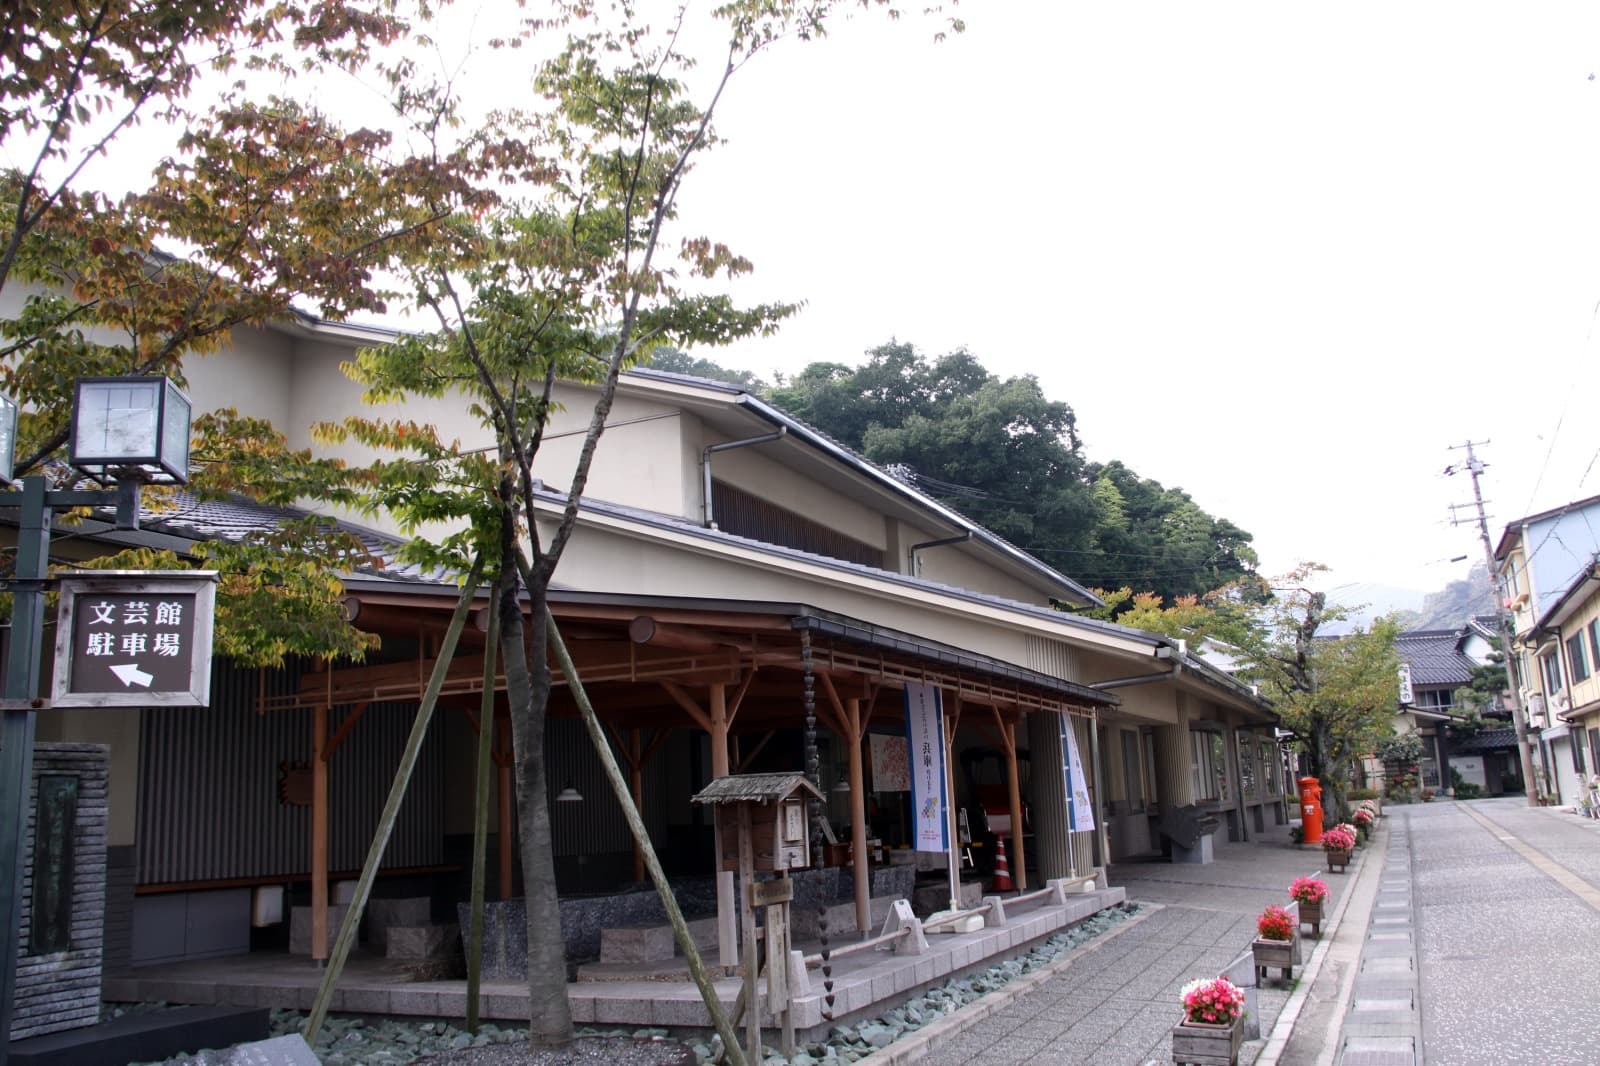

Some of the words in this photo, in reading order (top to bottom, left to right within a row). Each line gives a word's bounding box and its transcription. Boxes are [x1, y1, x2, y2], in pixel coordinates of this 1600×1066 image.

[88, 601, 182, 625] 文芸館
[86, 632, 180, 657] 駐車場
